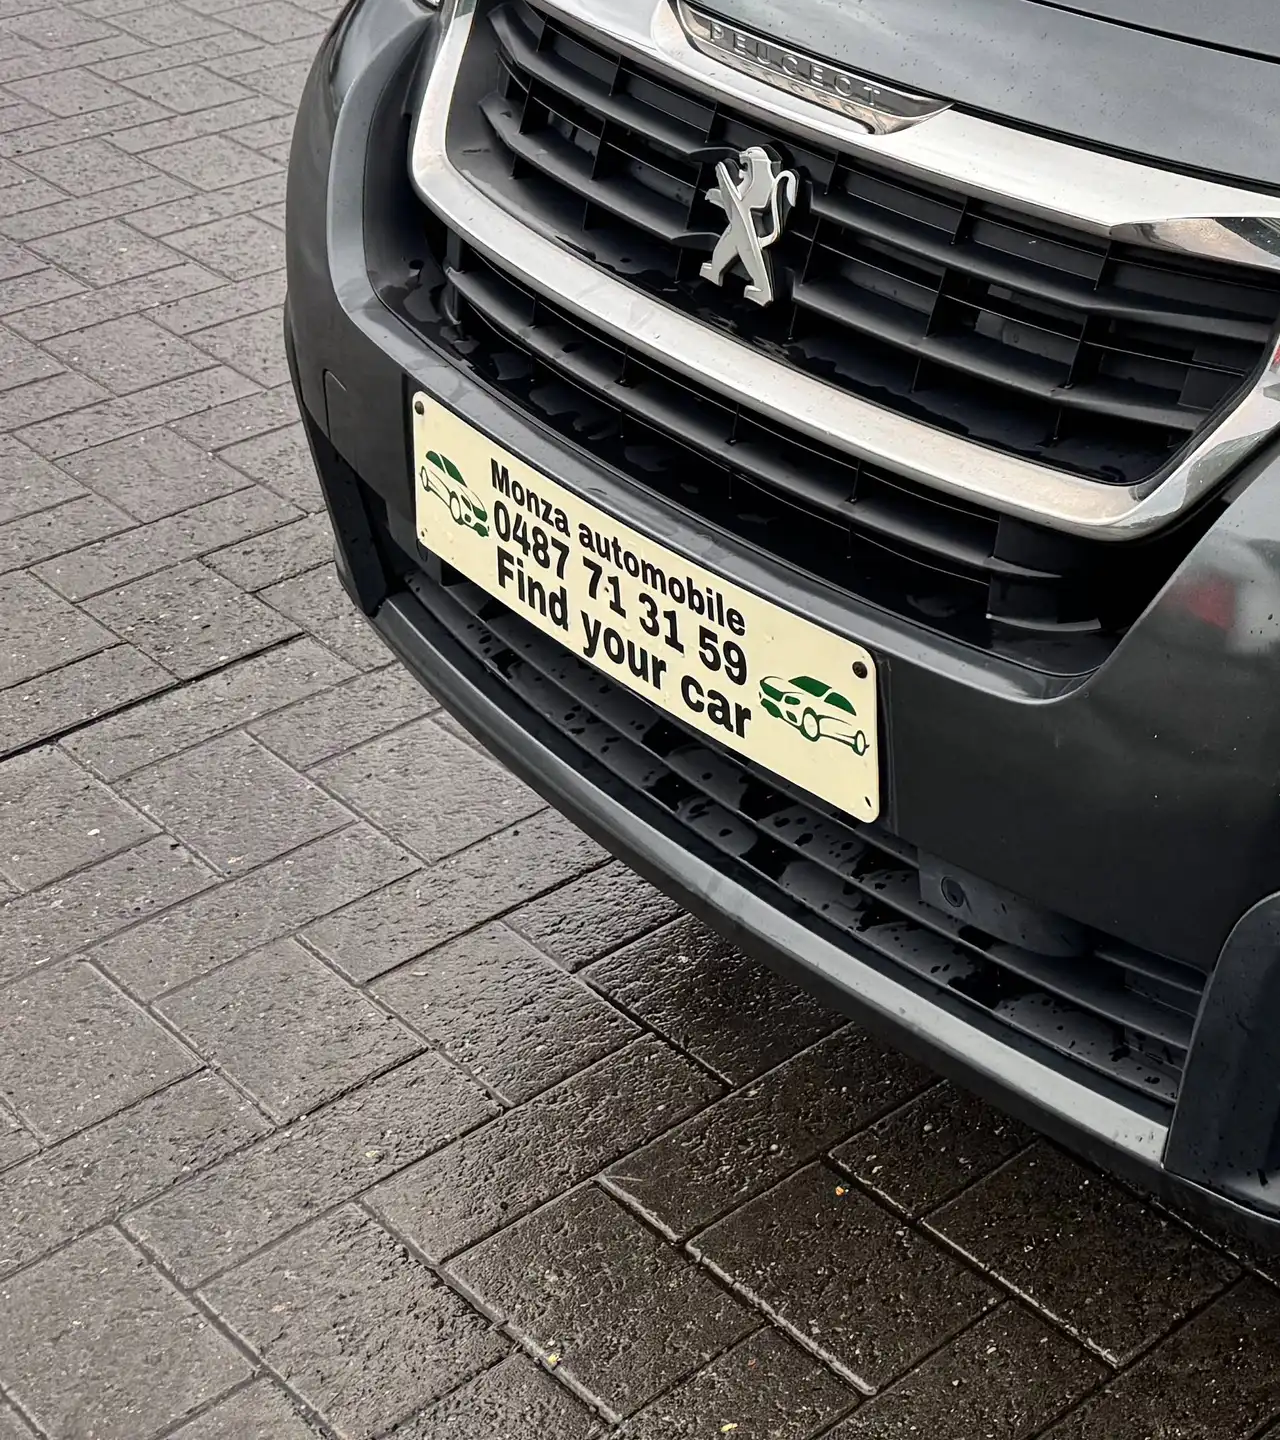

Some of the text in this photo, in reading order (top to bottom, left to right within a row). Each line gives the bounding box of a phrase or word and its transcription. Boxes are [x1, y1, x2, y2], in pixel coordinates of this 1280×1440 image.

[709, 21, 881, 106] PEUGEOT
[490, 457, 746, 637] Monza automobile
[493, 500, 748, 686] 0487 71 31 59
[496, 545, 752, 739] Find your car
